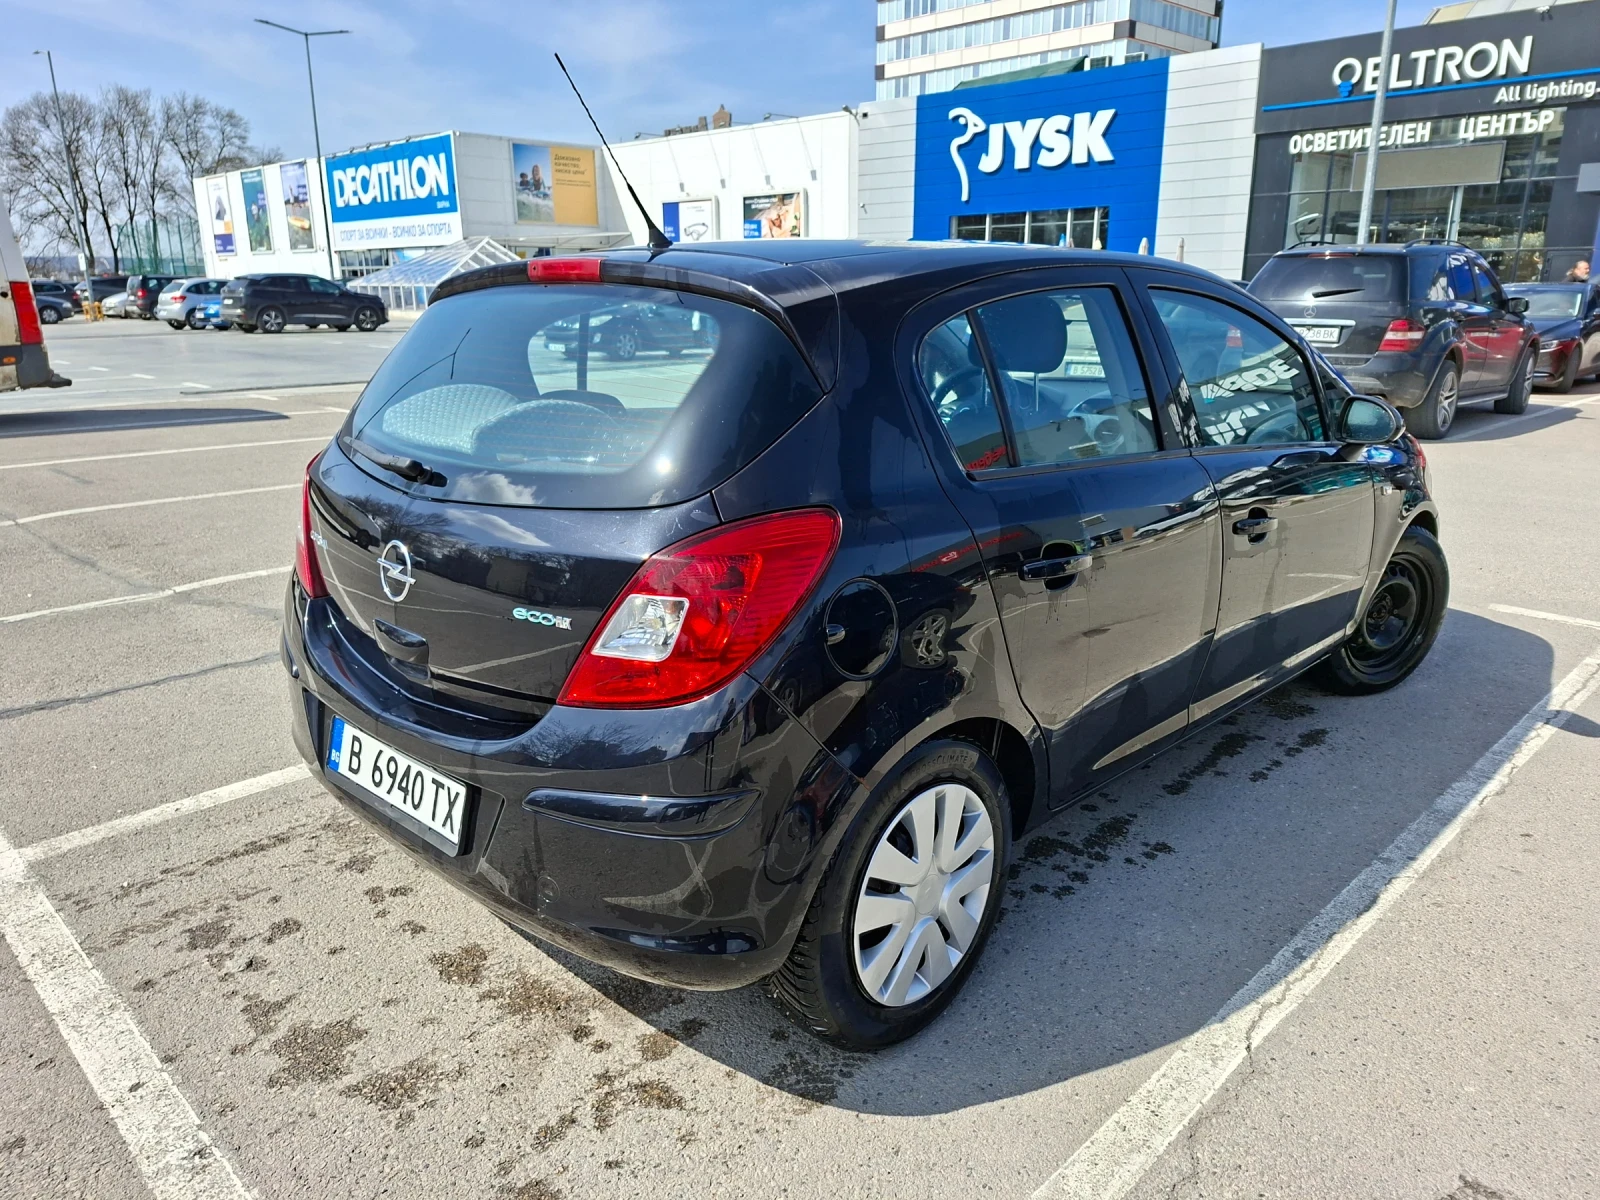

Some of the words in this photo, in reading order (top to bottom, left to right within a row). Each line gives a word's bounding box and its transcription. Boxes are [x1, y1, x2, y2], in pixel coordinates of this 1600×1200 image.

[1494, 86, 1520, 103] All
[1459, 110, 1554, 141] ЦЕНТЪР
[978, 109, 1116, 173] JYSK
[332, 152, 449, 208] DECATHLON
[340, 230, 356, 241] СПОРТ
[1323, 329, 1336, 339] BK
[331, 749, 340, 762] BG
[348, 734, 362, 775] B
[372, 750, 424, 811] 6940
[431, 777, 460, 835] TX
